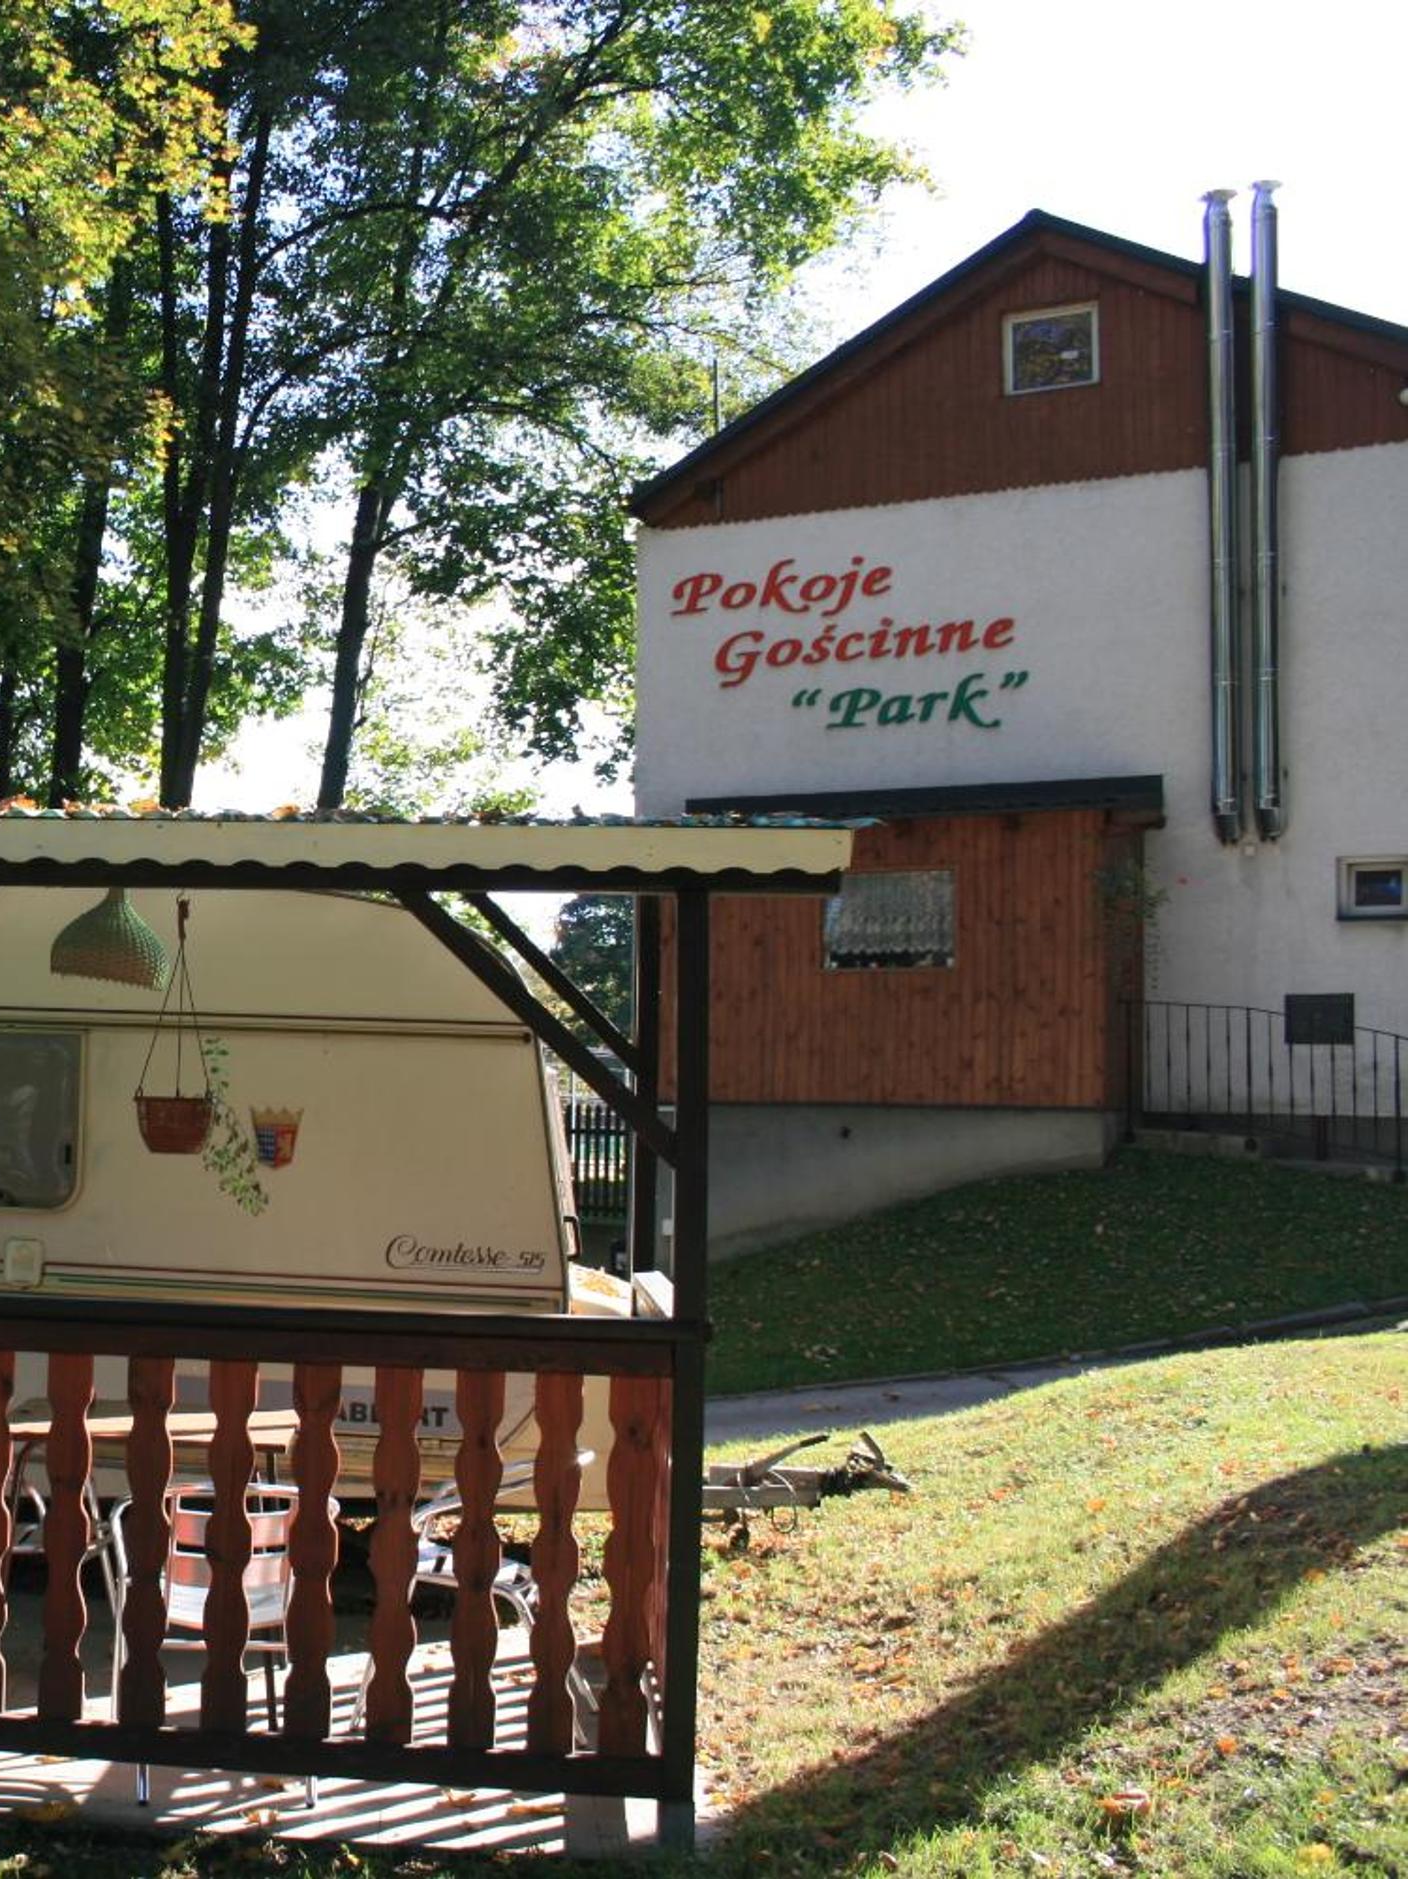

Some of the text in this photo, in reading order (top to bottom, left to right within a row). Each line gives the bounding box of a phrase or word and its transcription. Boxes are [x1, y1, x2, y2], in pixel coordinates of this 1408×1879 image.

[670, 556, 893, 618] Pokoje
[714, 616, 1016, 689] Gościnne
[386, 1234, 509, 1270] Comtesse
